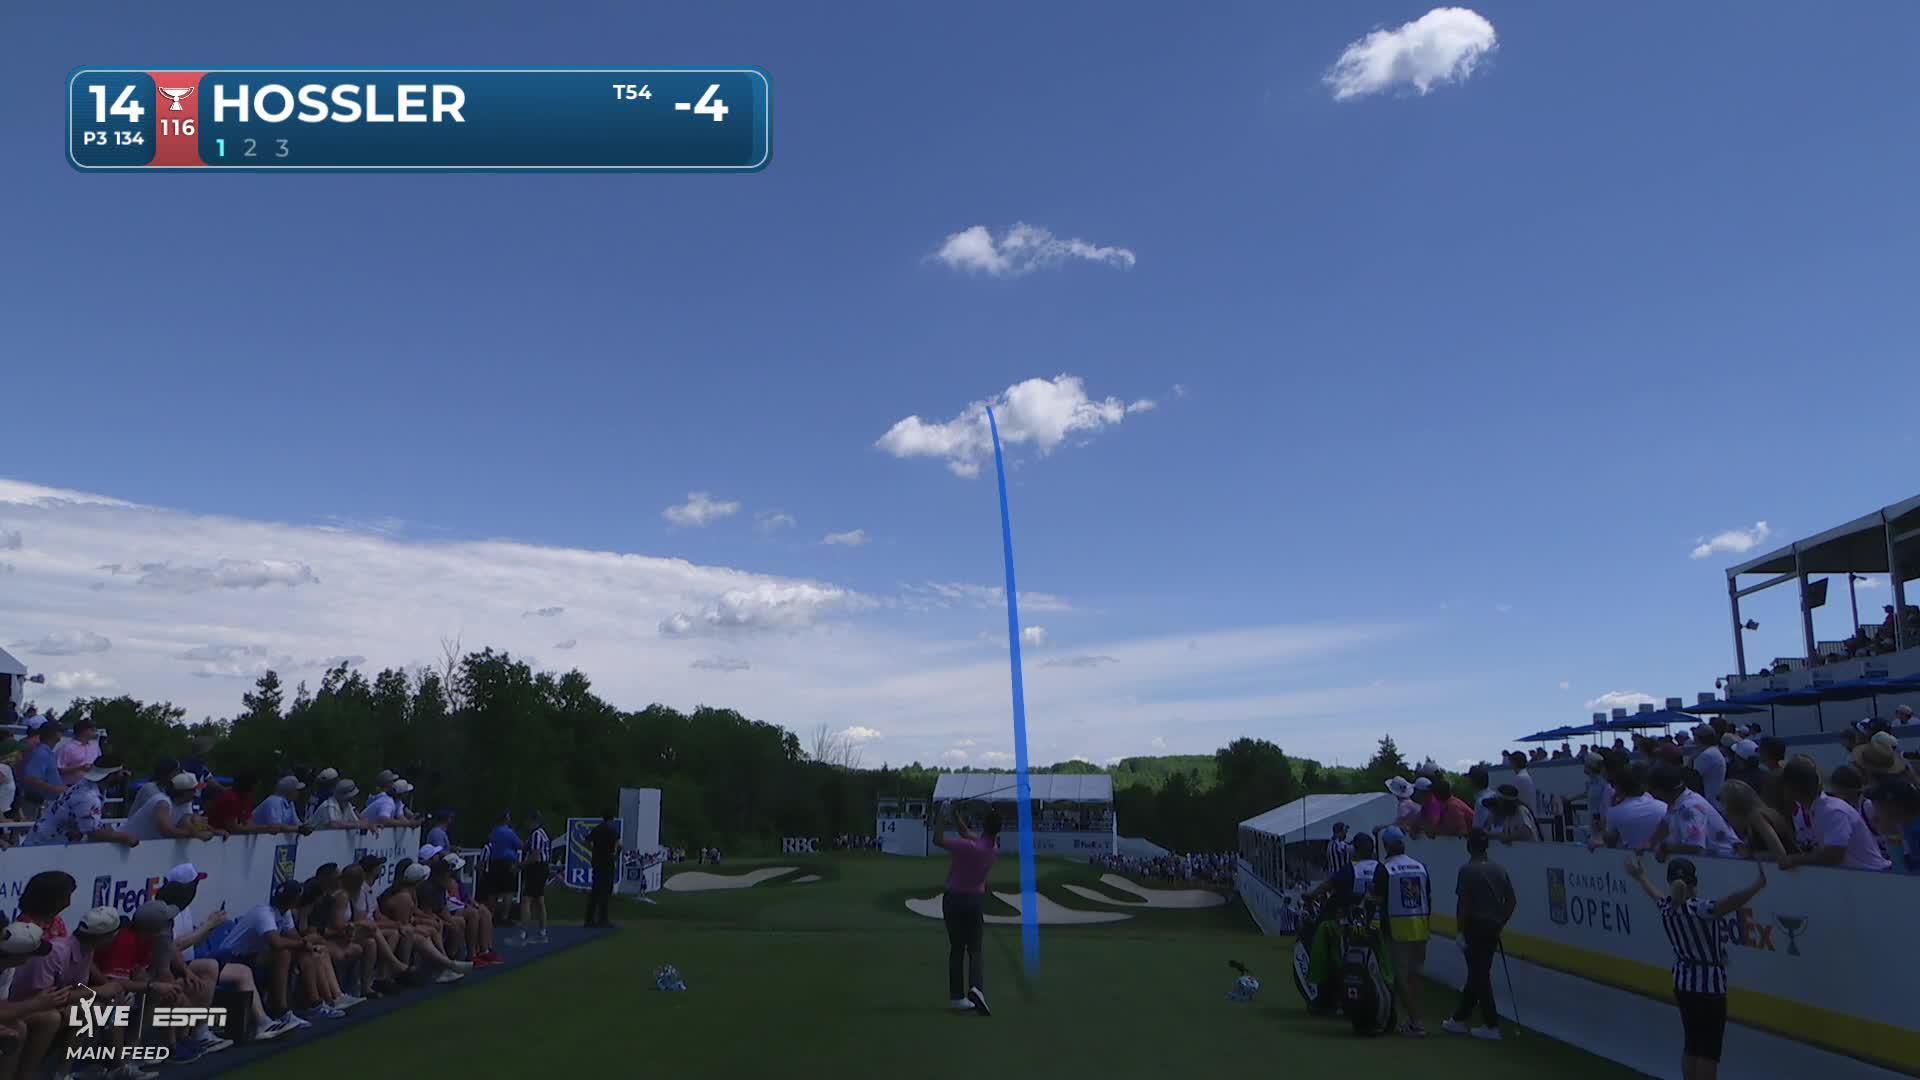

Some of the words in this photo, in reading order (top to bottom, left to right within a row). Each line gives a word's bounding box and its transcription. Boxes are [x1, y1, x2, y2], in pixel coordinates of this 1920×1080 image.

[882, 820, 896, 833] 14
[782, 836, 820, 853] RBC
[1568, 871, 1627, 895] CANADIAN
[1571, 896, 1631, 935] OPEN
[1719, 907, 1777, 952] edEx
